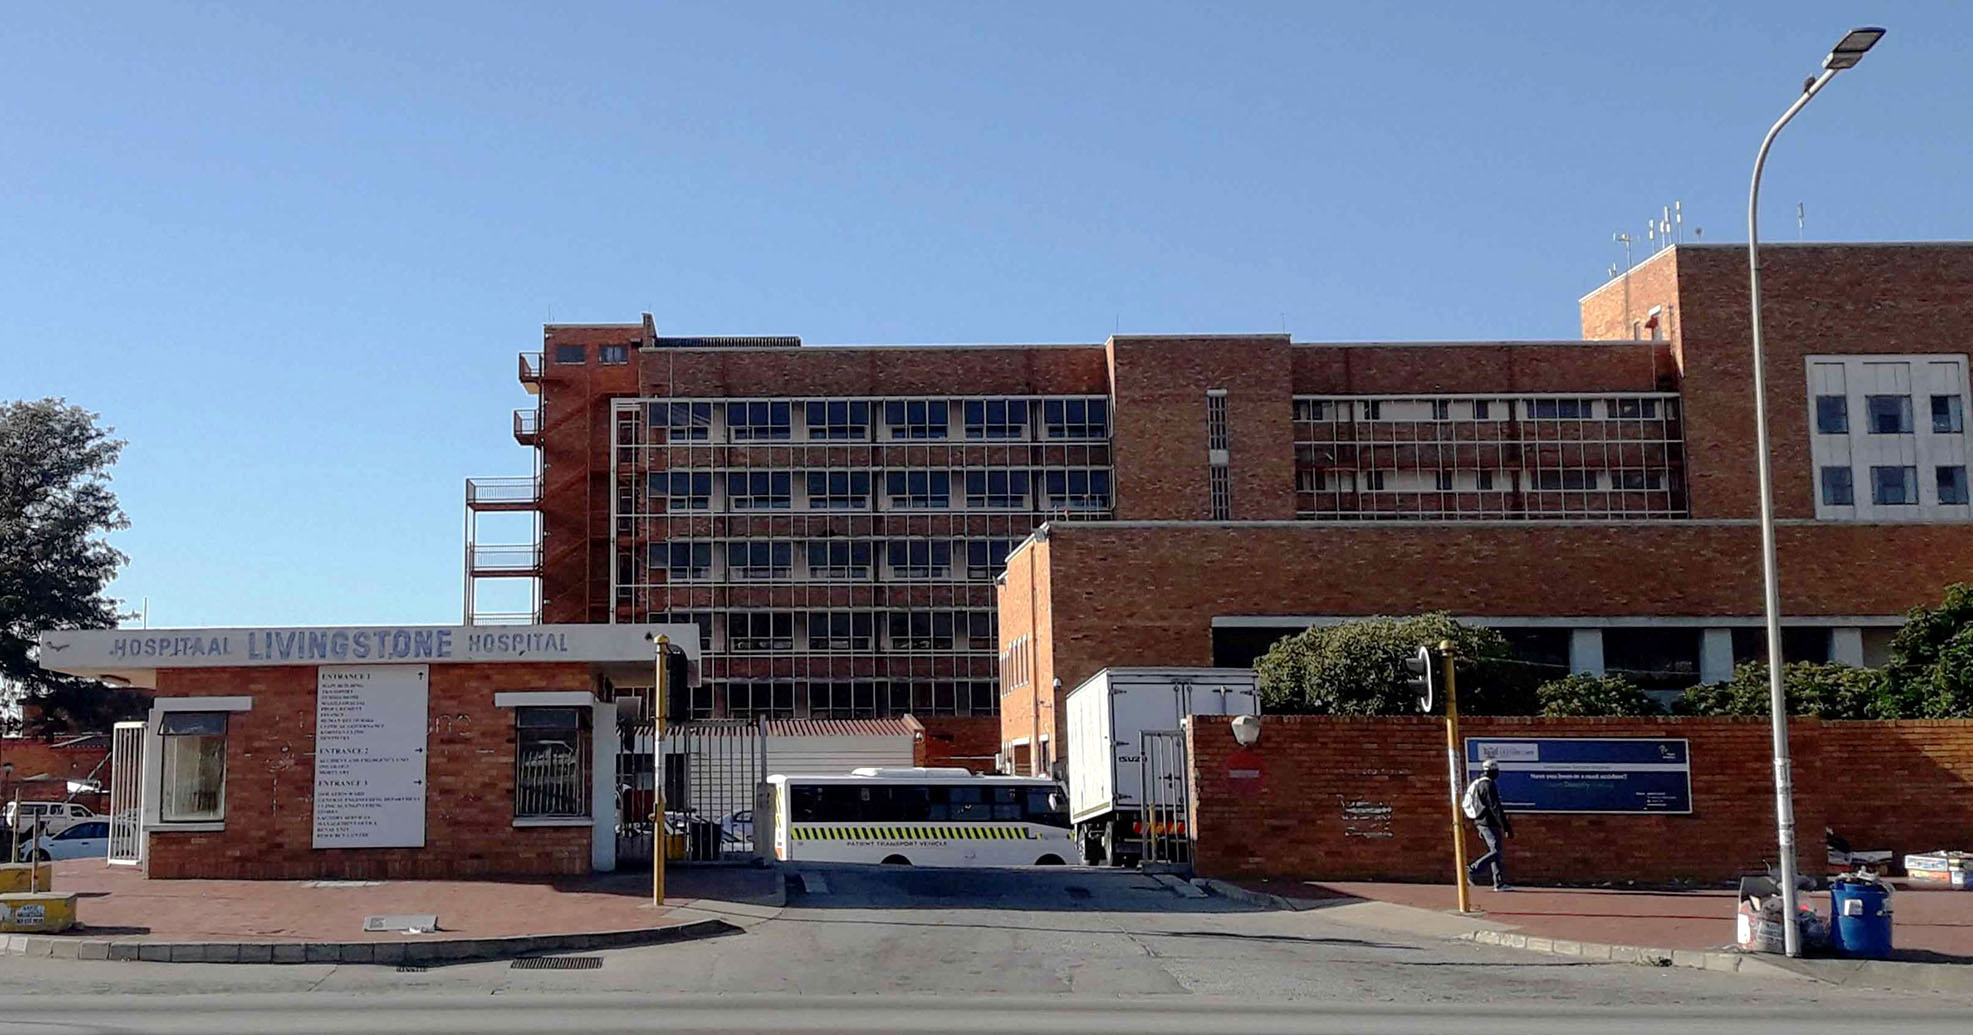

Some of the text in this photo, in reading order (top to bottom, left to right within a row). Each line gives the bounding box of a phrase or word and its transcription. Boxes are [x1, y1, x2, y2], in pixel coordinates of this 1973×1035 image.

[114, 630, 568, 660] HOSPITAAL LIVINGSTONE HOSPITAL
